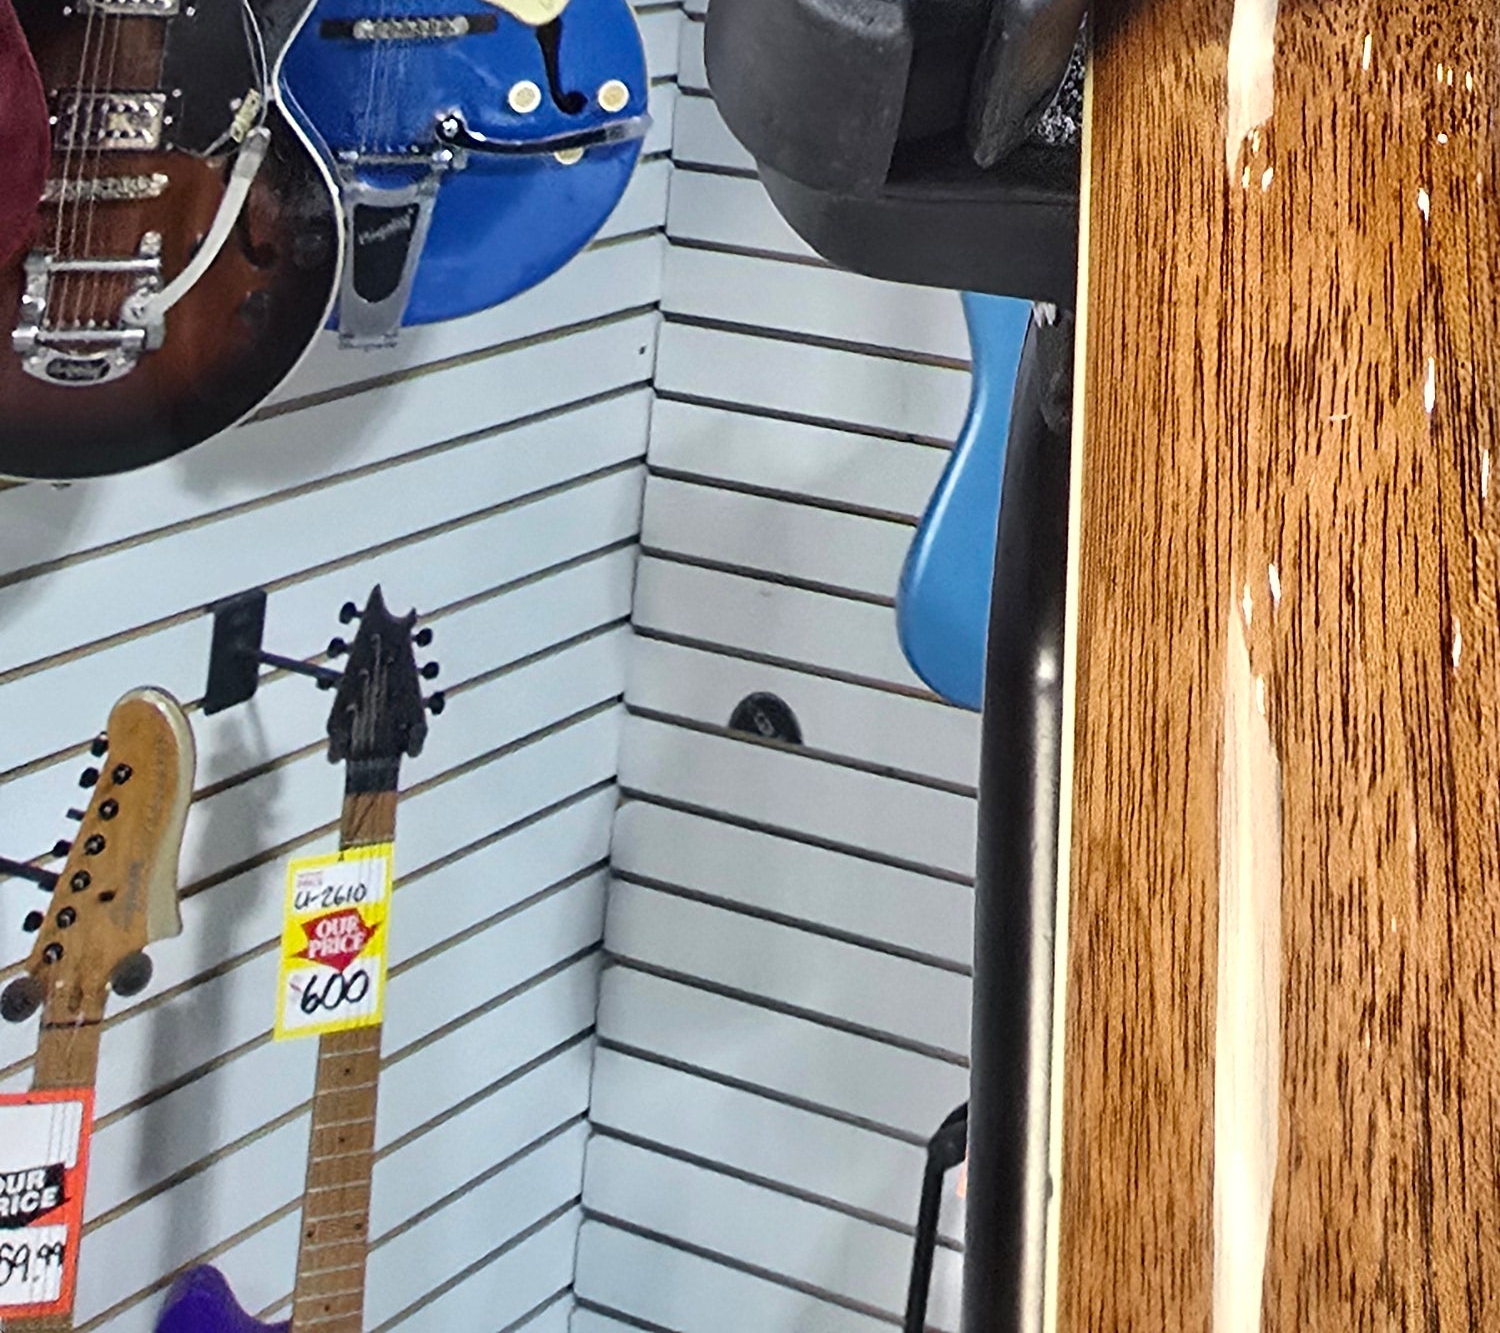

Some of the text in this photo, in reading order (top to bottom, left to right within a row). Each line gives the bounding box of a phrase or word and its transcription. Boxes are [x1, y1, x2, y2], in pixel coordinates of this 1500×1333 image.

[315, 914, 361, 938] OUR
[307, 930, 367, 958] PRICE
[0, 1186, 59, 1217] RICE
